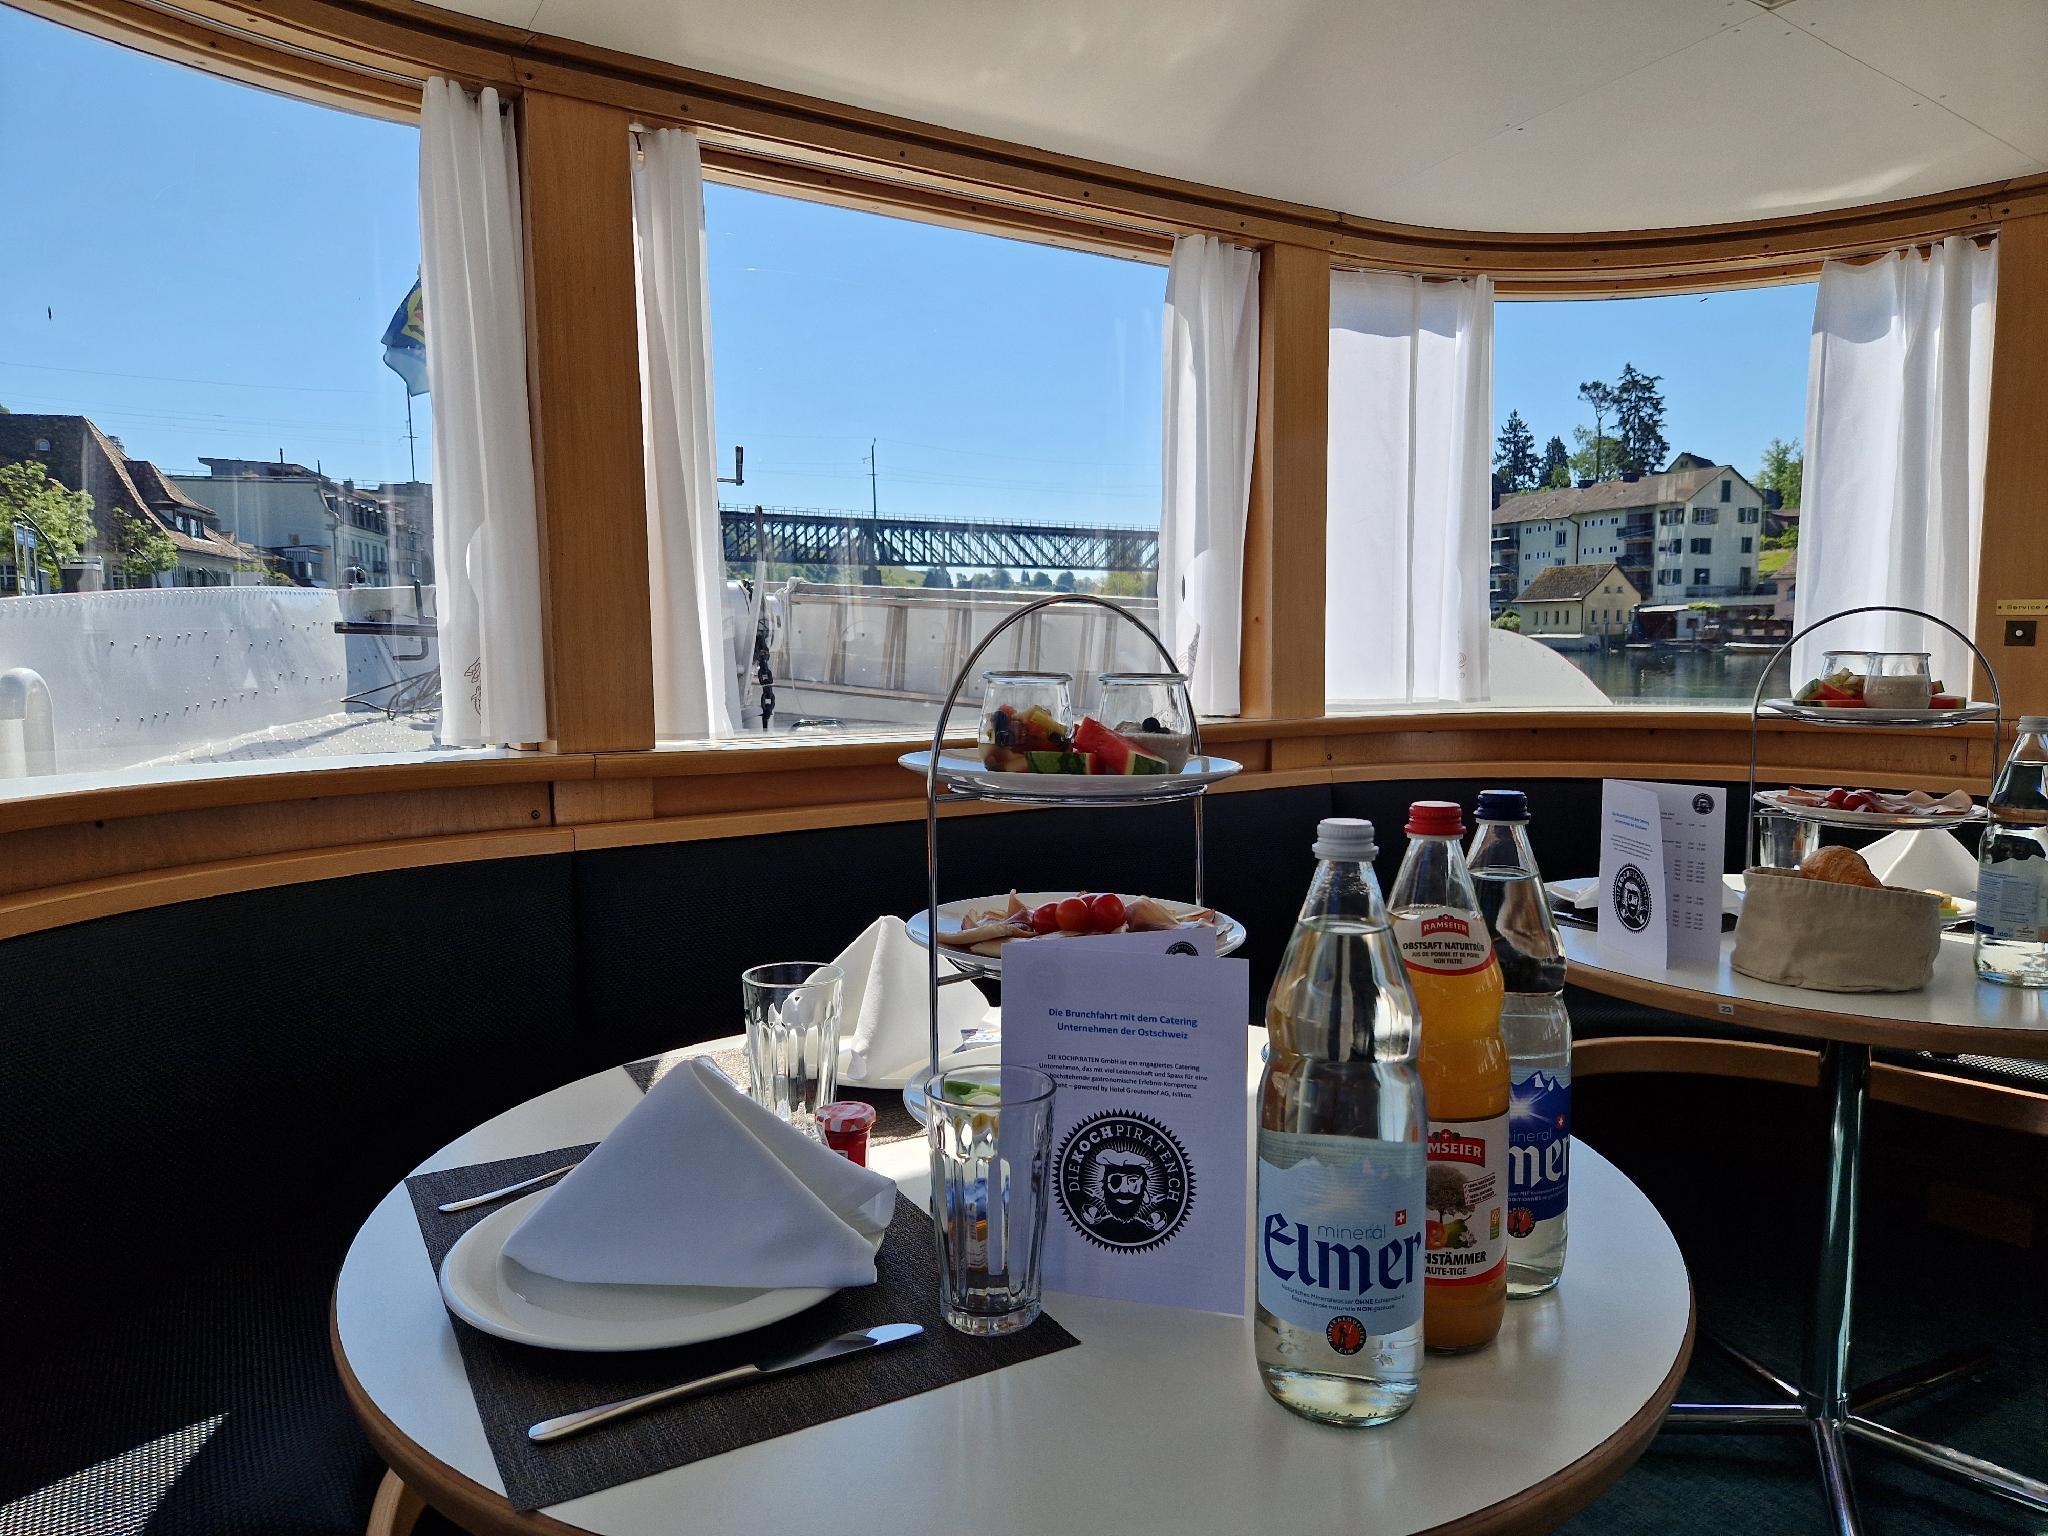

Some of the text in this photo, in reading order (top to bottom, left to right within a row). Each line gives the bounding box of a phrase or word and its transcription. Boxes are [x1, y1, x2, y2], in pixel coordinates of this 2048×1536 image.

[1424, 922, 1468, 932] RAMSEIER
[1402, 942, 1442, 950] OBSTSAFT
[1048, 1008, 1198, 1028] Die Brunchfahrt mit dem Catering
[1057, 1022, 1188, 1040] Unternehmen der Ostschweiz
[1058, 1054, 1100, 1063] KOCHPIRATEN
[1138, 1060, 1174, 1069] engagiertes
[1174, 1063, 1200, 1072] Catering
[1116, 1068, 1153, 1077] Leidenschaft
[1167, 1072, 1184, 1080] Spass
[1074, 1084, 1100, 1092] powered
[1511, 1128, 1552, 1142] ineral
[1428, 1142, 1482, 1158] MSEIER
[1508, 1136, 1569, 1188] mer
[1318, 1224, 1386, 1240] mineral
[1264, 1213, 1422, 1296] Elmer
[1424, 1250, 1487, 1265] HSTÄMMER
[1424, 1266, 1467, 1276] AUTE-TIGE
[1354, 1298, 1374, 1306] OHNE
